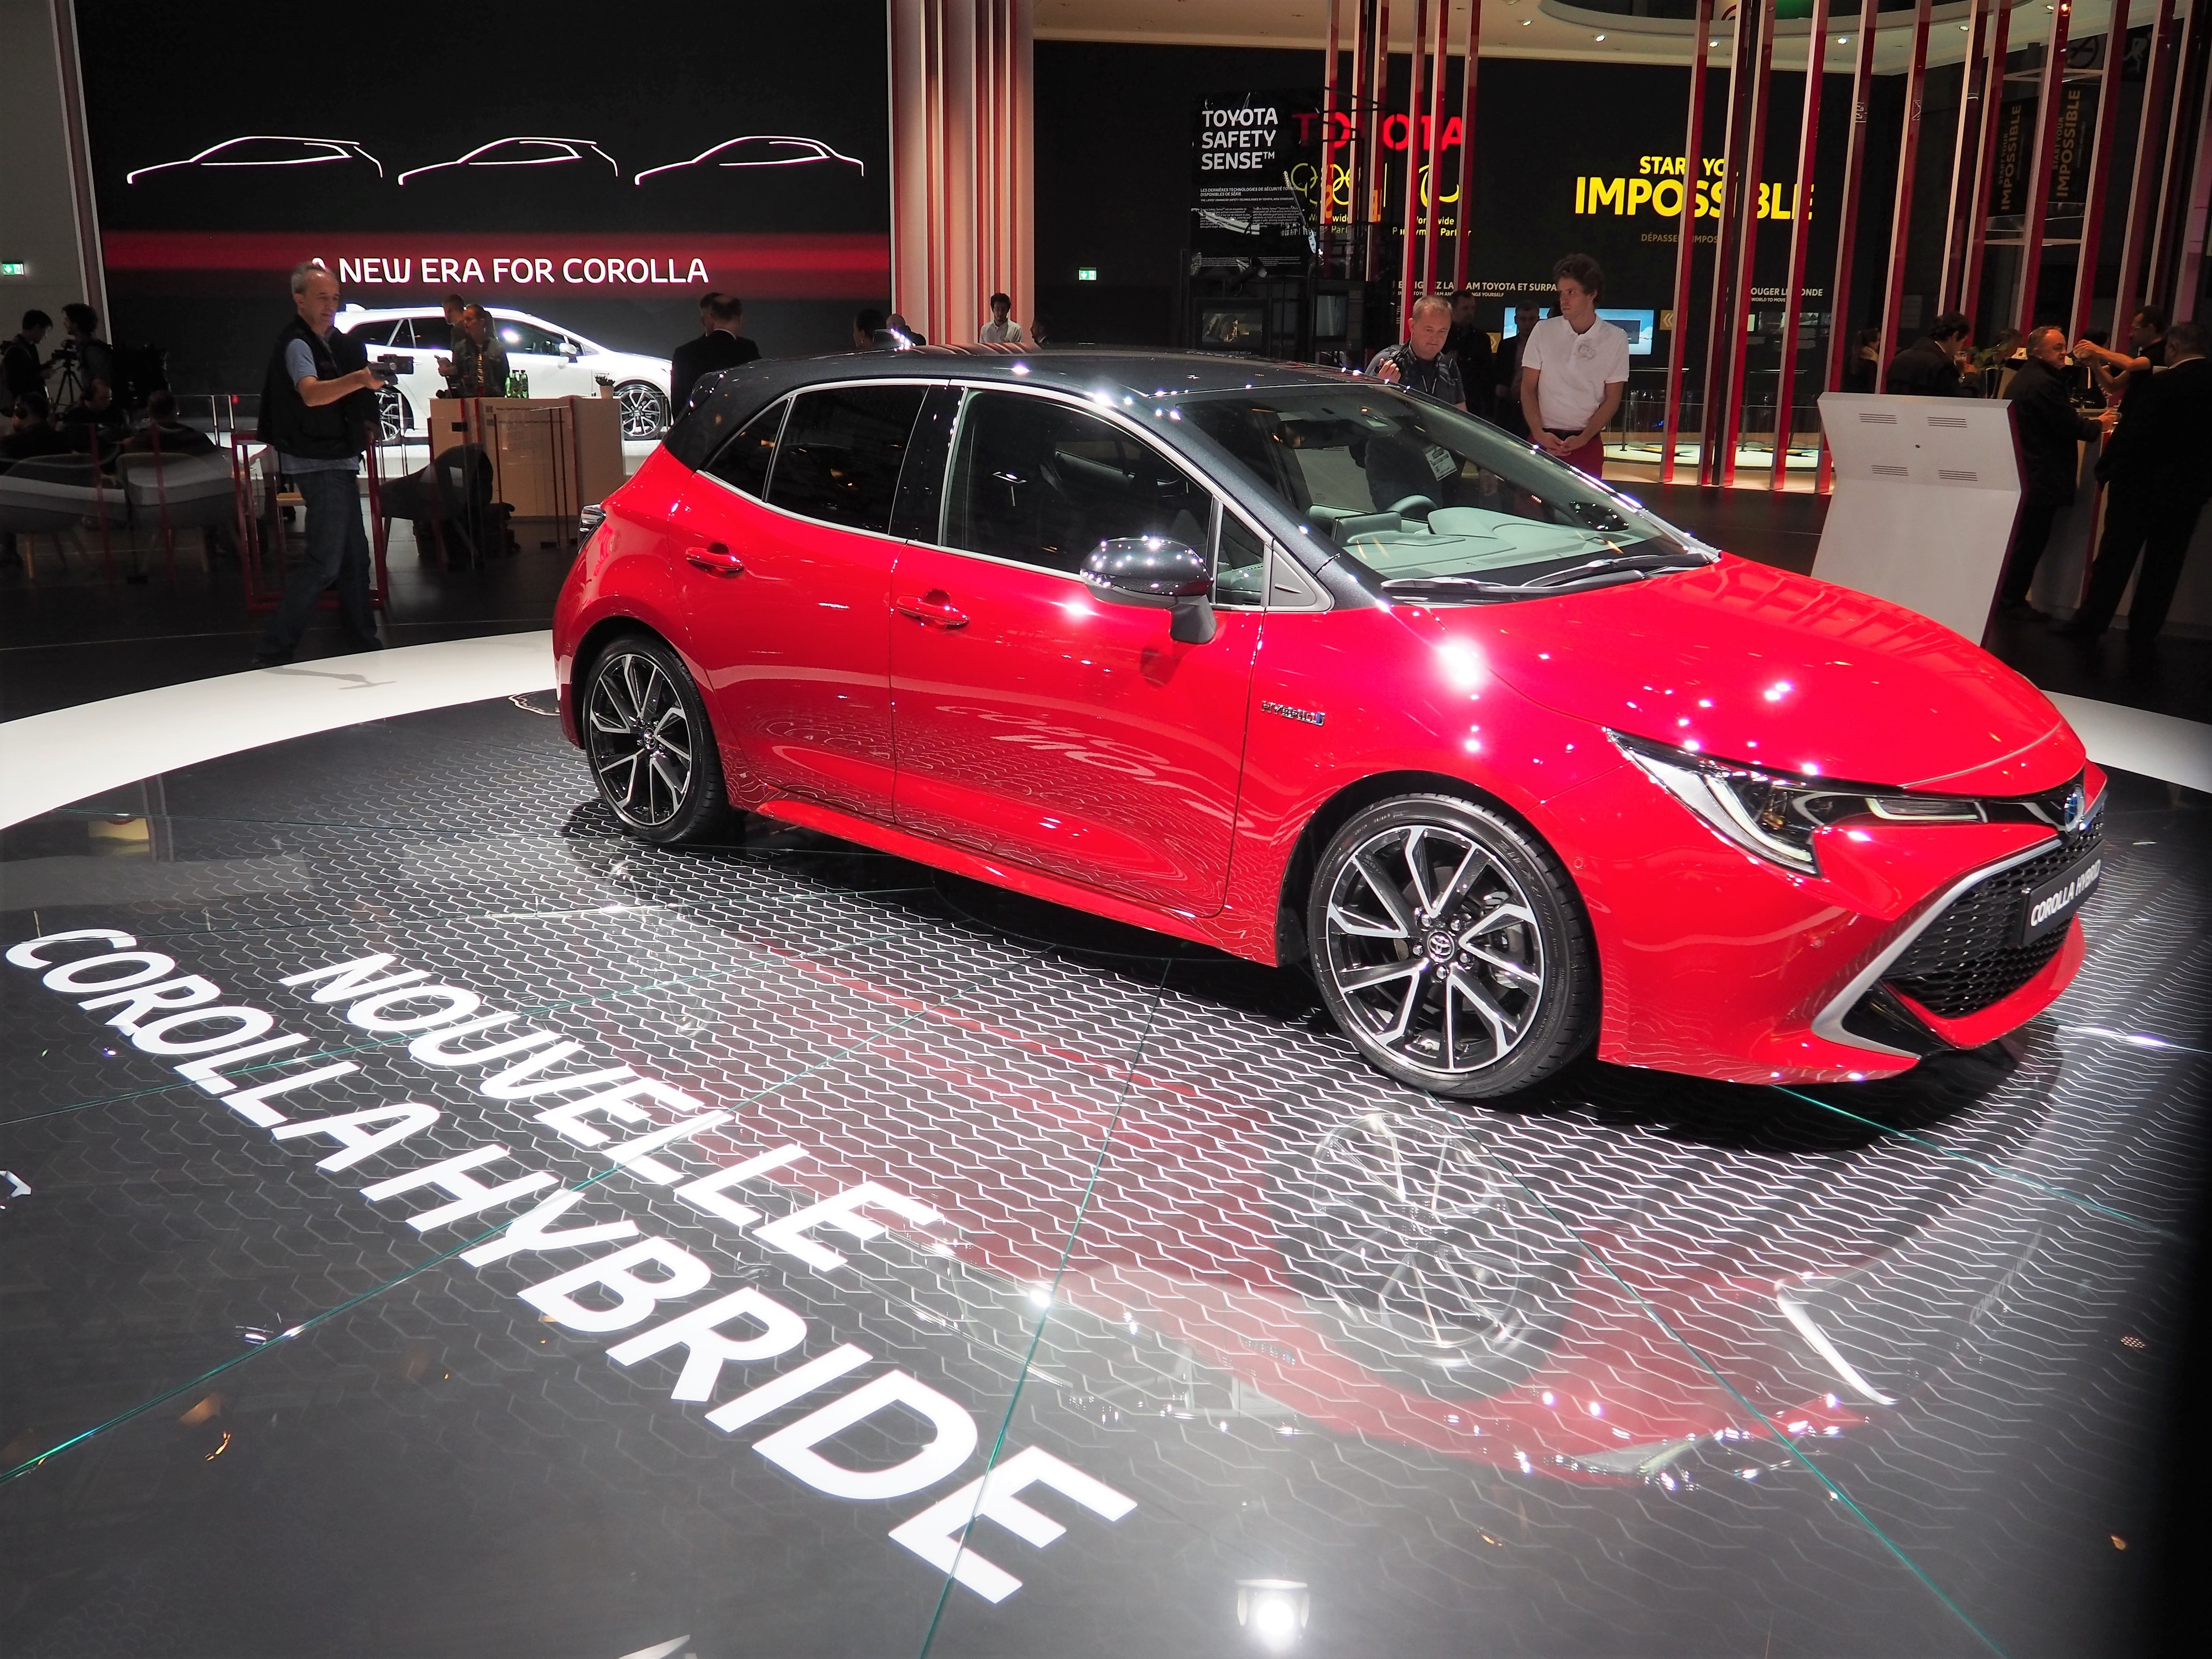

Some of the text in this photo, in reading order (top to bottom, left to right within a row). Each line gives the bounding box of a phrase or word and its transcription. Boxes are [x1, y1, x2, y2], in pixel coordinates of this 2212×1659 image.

[1202, 107, 1278, 127] TOYOTA
[2056, 117, 2064, 142] YOUR
[1202, 129, 1276, 149] SAFETY
[1292, 112, 1462, 152] TOOTA
[2056, 90, 2080, 197] IMPOSSIBLE
[1639, 156, 1686, 175] STAR
[2000, 105, 2021, 211] IMPOSSIBLE
[1575, 176, 1814, 220] IMPOSSBL
[1641, 232, 1679, 242] DÉPASSE
[339, 258, 410, 283] NEW
[421, 258, 484, 283] ERA
[493, 258, 555, 283] FOR
[563, 258, 709, 283] COROLLA
[1443, 281, 1454, 290] LA
[1465, 282, 1480, 290] AM
[1481, 283, 1516, 291] TOYOTA
[1517, 283, 1528, 291] ET
[1529, 283, 1558, 291] SURPA
[1751, 287, 1780, 295] OUGER
[1801, 288, 1823, 296] ONDE
[2030, 859, 2101, 927] COROLLA HYBRID
[278, 952, 947, 1272] NOUVELLE
[6, 928, 1138, 1604] COROLLA HYBRIDE
